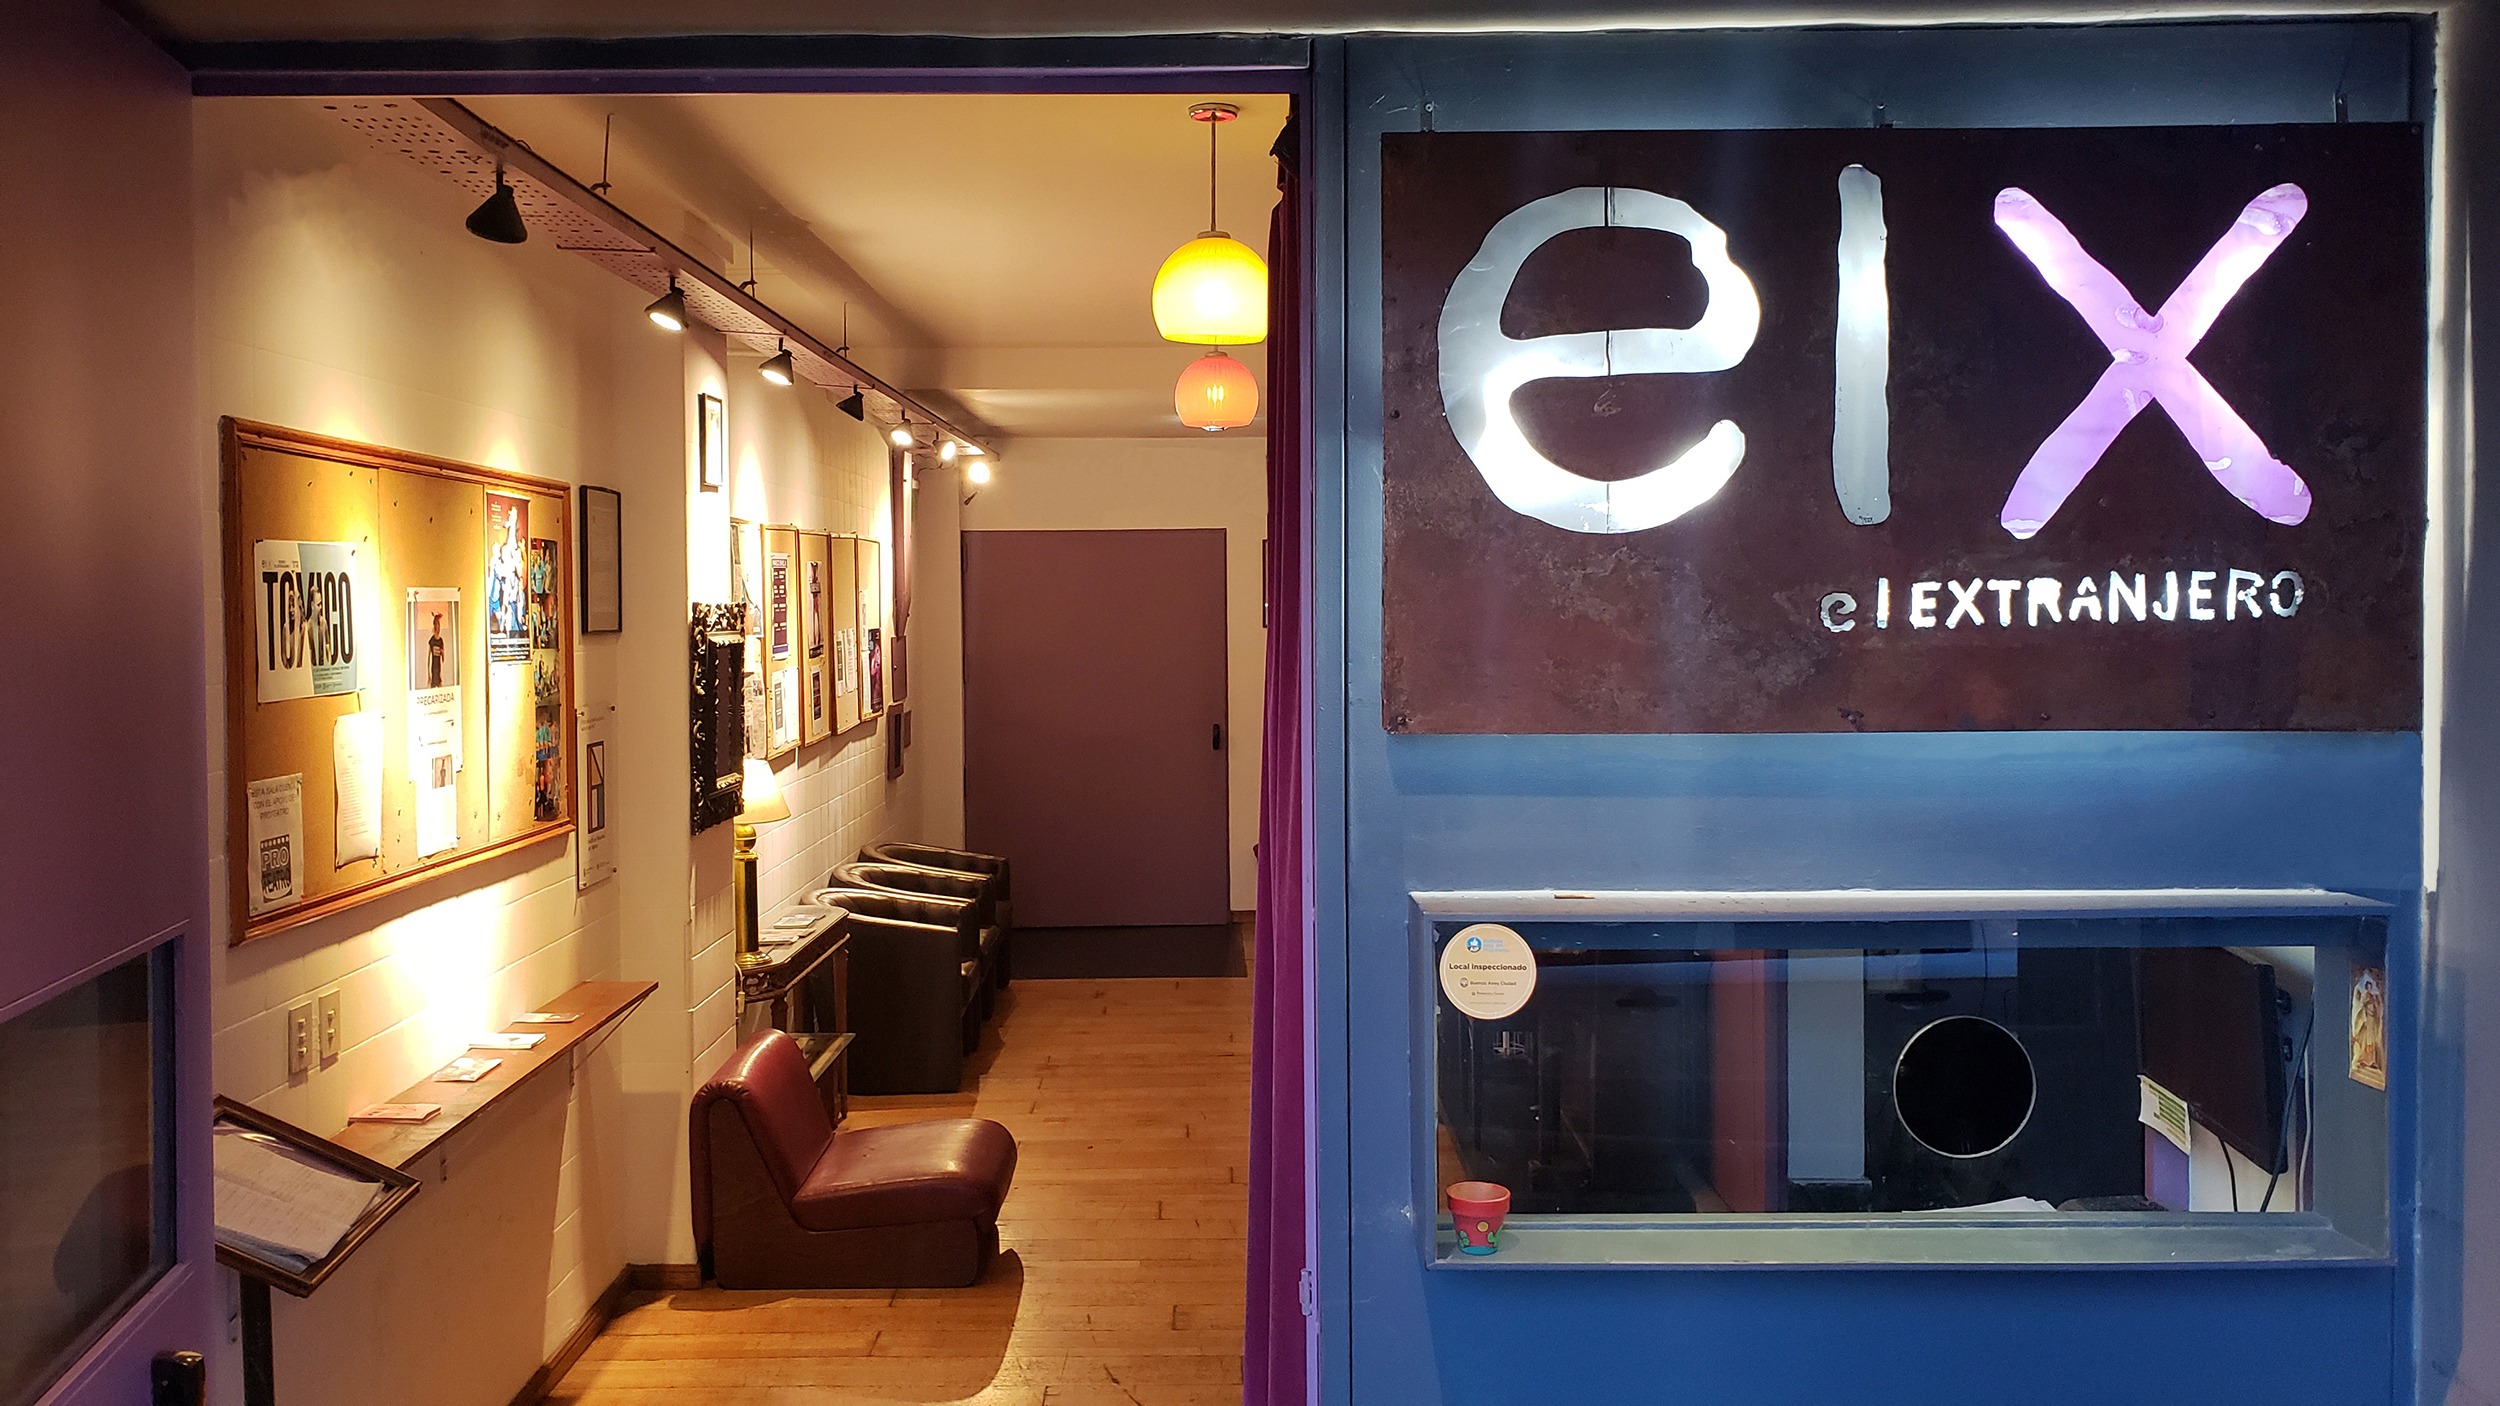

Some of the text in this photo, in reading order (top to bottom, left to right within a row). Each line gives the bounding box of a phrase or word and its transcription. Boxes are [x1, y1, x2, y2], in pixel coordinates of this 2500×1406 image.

[1909, 570, 2305, 629] EXTRANJERO
[262, 846, 290, 871] PRO
[1471, 963, 1527, 971] Inspeccionado
